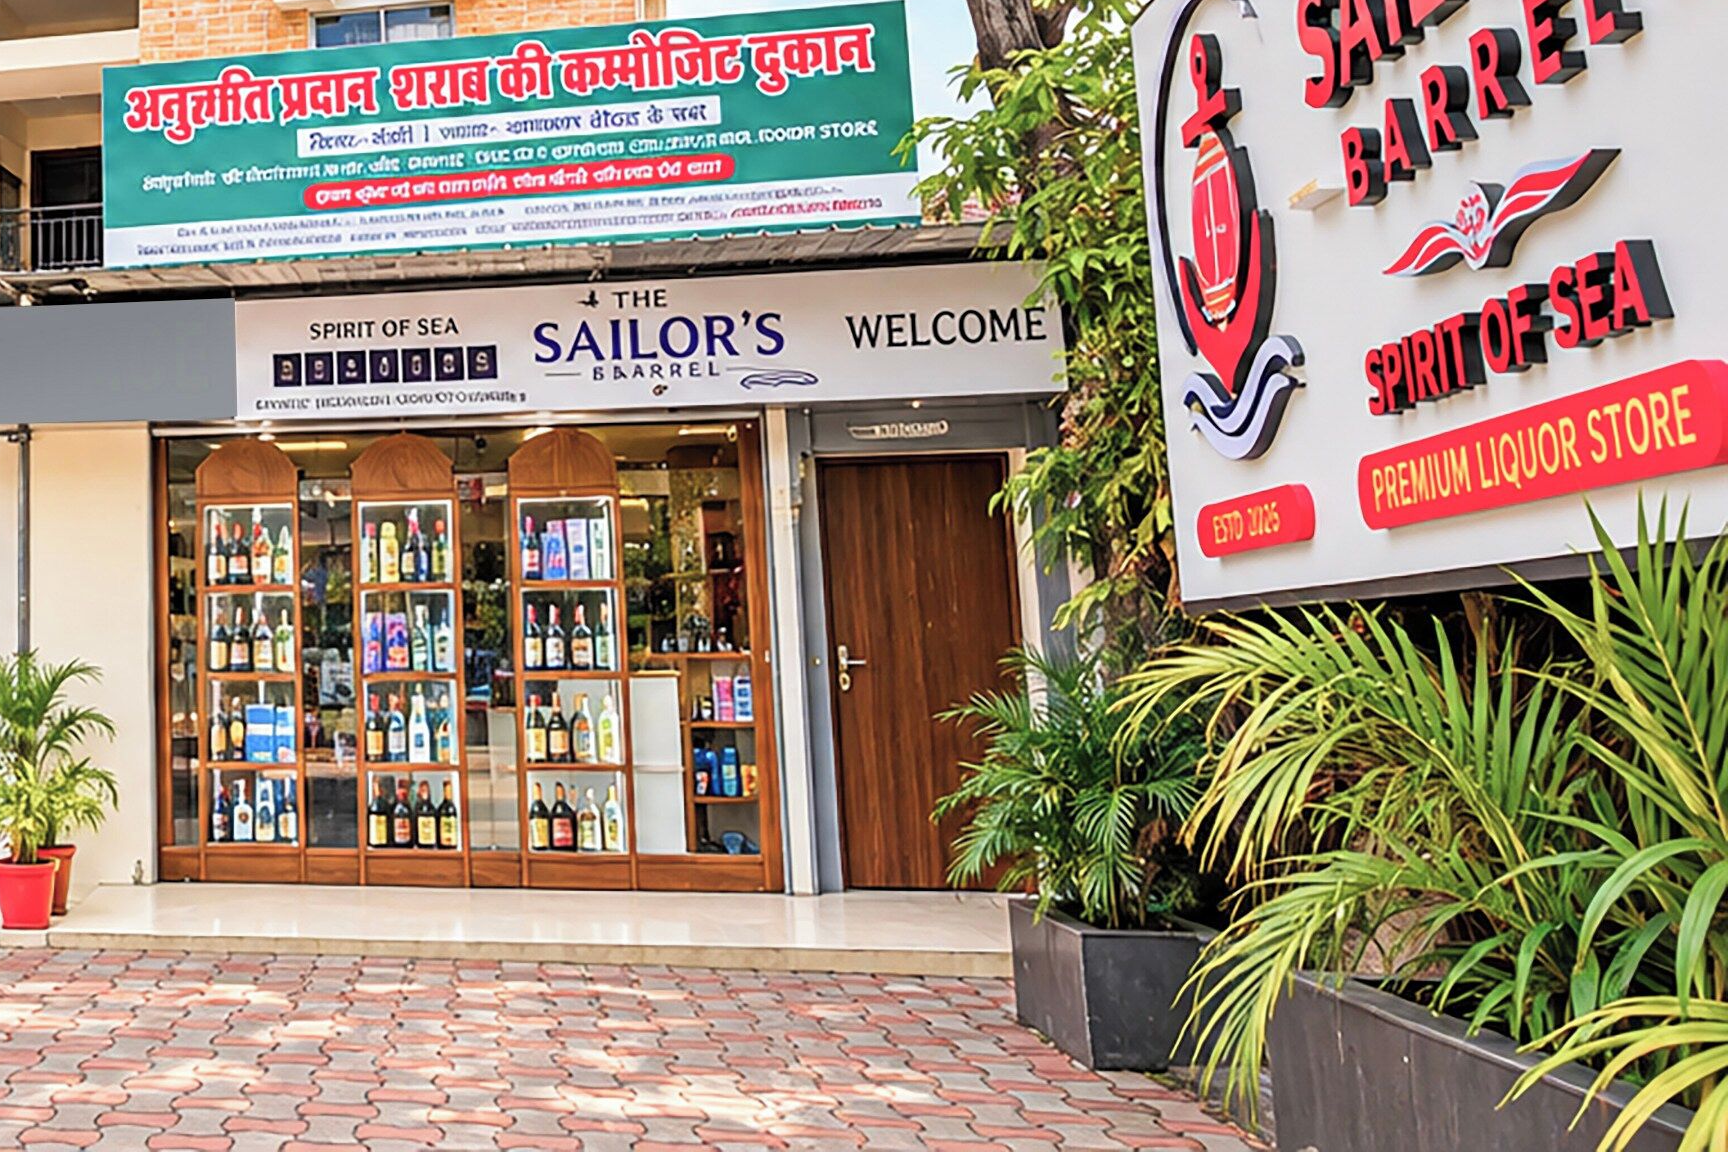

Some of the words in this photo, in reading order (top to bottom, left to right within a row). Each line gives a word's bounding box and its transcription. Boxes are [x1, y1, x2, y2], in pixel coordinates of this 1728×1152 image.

[277, 70, 379, 122] प्रदान
[390, 60, 490, 109] शराब
[496, 42, 552, 99] की
[747, 26, 873, 94] दुकान
[611, 288, 668, 309] THE
[309, 321, 375, 341] SPIRIT
[381, 318, 411, 338] OF
[417, 316, 460, 336] SEA
[533, 309, 786, 363] SAILOR'S
[845, 307, 1048, 350] WELCOME
[1365, 312, 1487, 416] SPIRIT
[1480, 283, 1554, 373] OF
[1549, 239, 1675, 349] SEA
[1372, 445, 1472, 513] PREMIUM
[1475, 416, 1582, 489] LIQUOR
[1586, 384, 1697, 464] STORE
